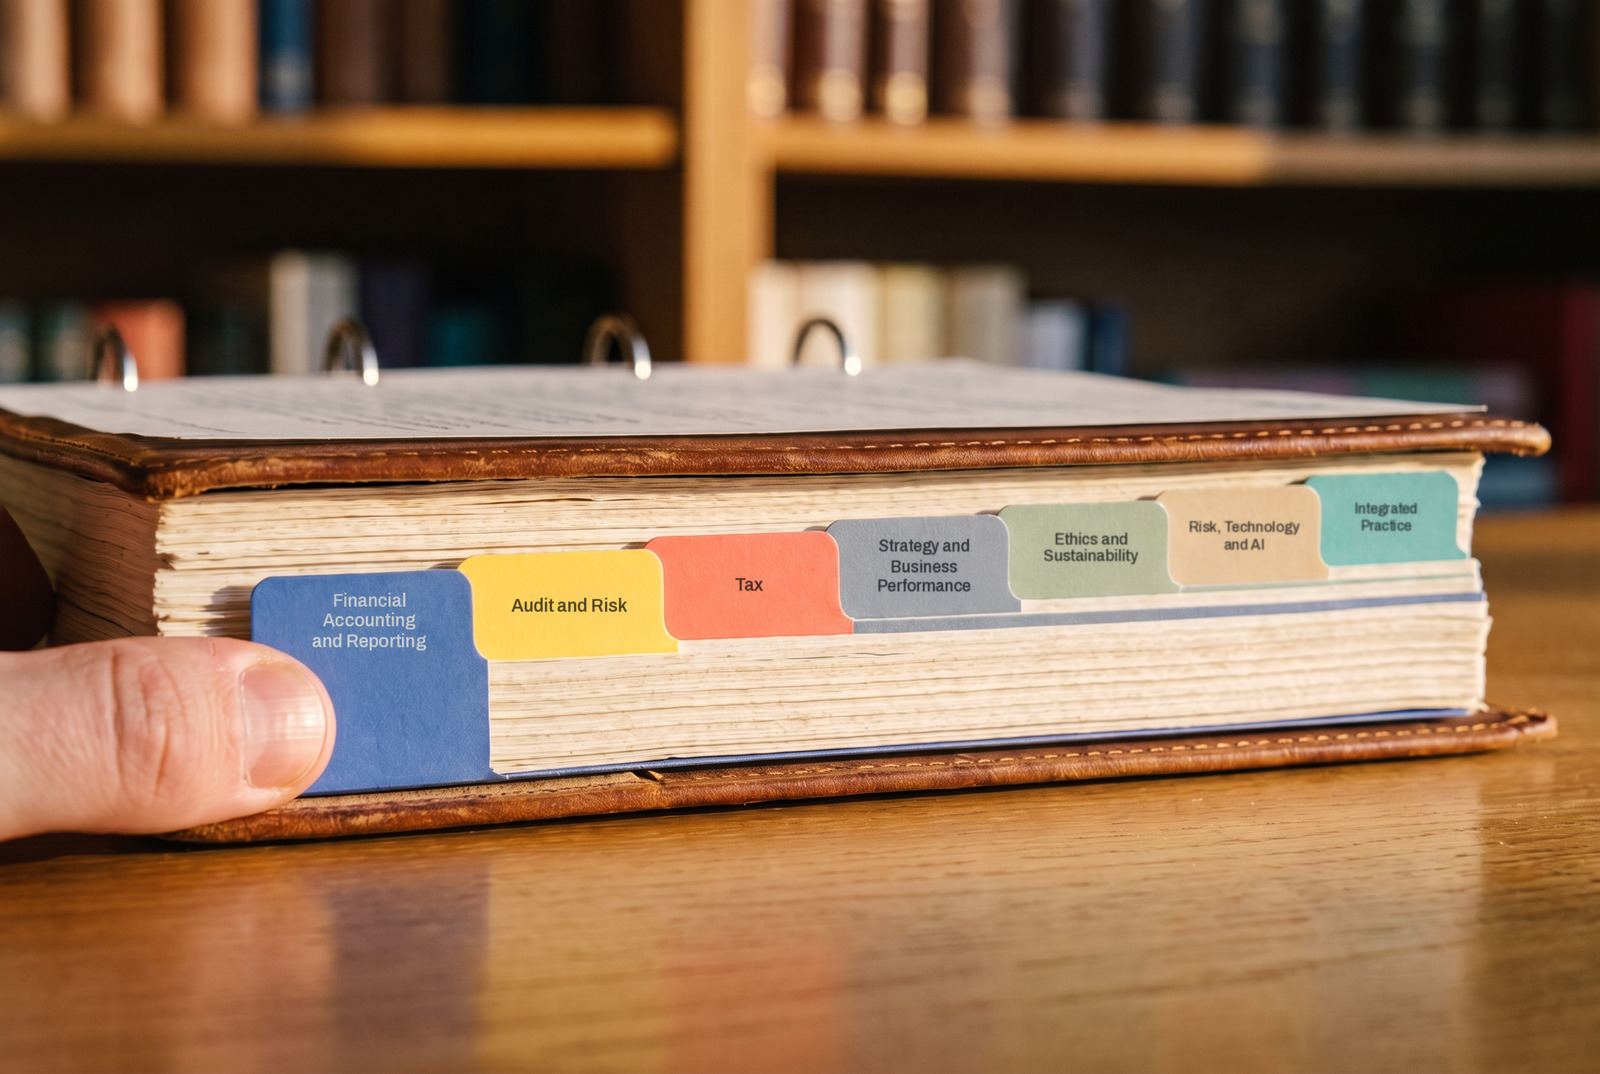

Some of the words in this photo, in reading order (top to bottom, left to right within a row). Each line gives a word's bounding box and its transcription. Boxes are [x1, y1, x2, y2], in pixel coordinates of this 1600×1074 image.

[1355, 502, 1418, 517] Integrated
[1188, 520, 1221, 535] Risk,
[1224, 520, 1301, 536] Technology
[1361, 519, 1413, 532] Practice
[1054, 532, 1098, 546] Ethics
[1101, 532, 1129, 546] and
[1224, 537, 1249, 551] and
[1251, 537, 1265, 551] AI
[878, 538, 939, 556] Strategy
[942, 538, 970, 554] and
[1043, 549, 1138, 565] Sustainability
[890, 559, 958, 574] Business
[735, 578, 764, 592] Tax
[877, 578, 971, 593] Performance
[333, 592, 407, 608] Financial
[511, 597, 554, 613] Audit
[557, 597, 588, 613] and
[592, 597, 628, 613] Risk
[323, 612, 417, 631] Accounting
[312, 633, 343, 649] and
[347, 633, 427, 652] Reporting
